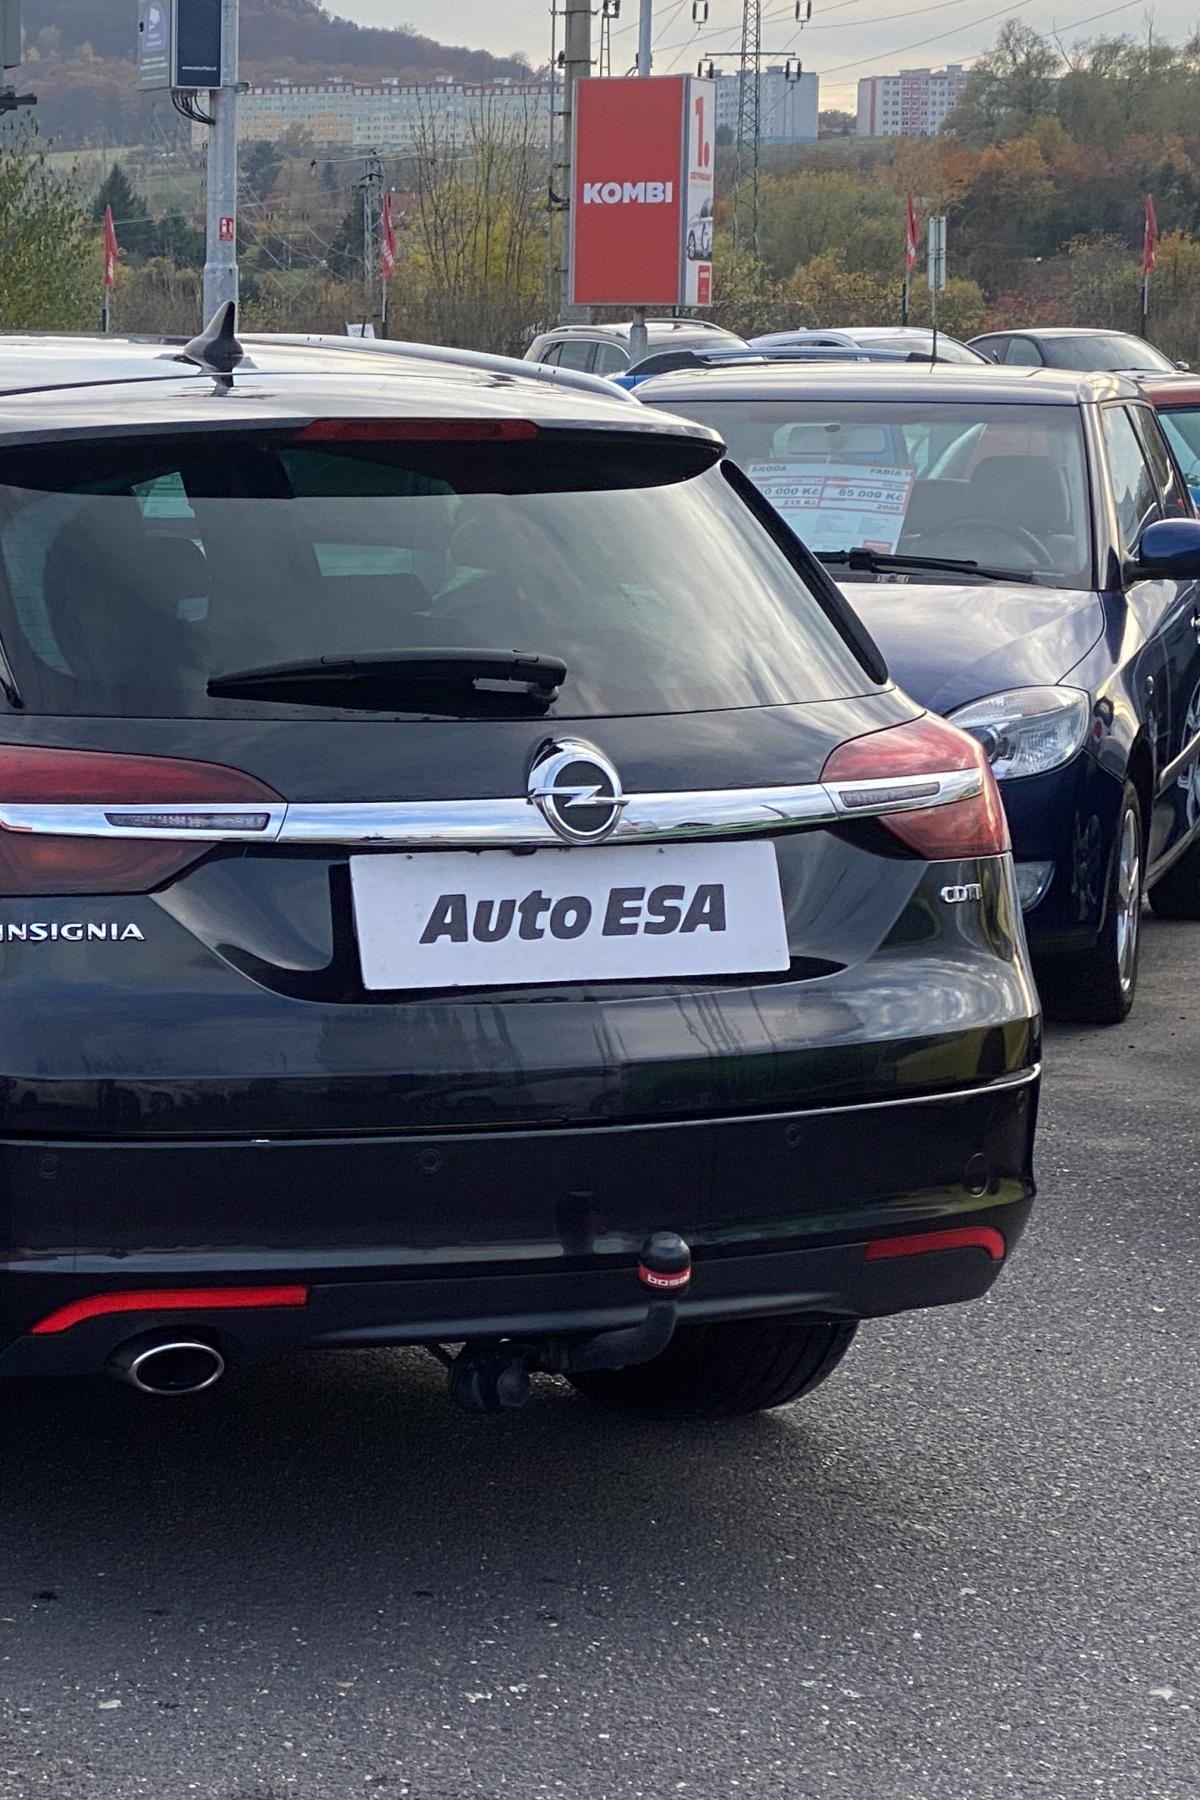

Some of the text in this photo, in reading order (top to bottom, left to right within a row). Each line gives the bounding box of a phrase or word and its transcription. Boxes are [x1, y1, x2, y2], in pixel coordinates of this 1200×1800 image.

[583, 181, 673, 204] KOMBI
[870, 467, 902, 477] FABIA
[418, 883, 727, 944] Auto ESA
[647, 1270, 691, 1287] bosal
